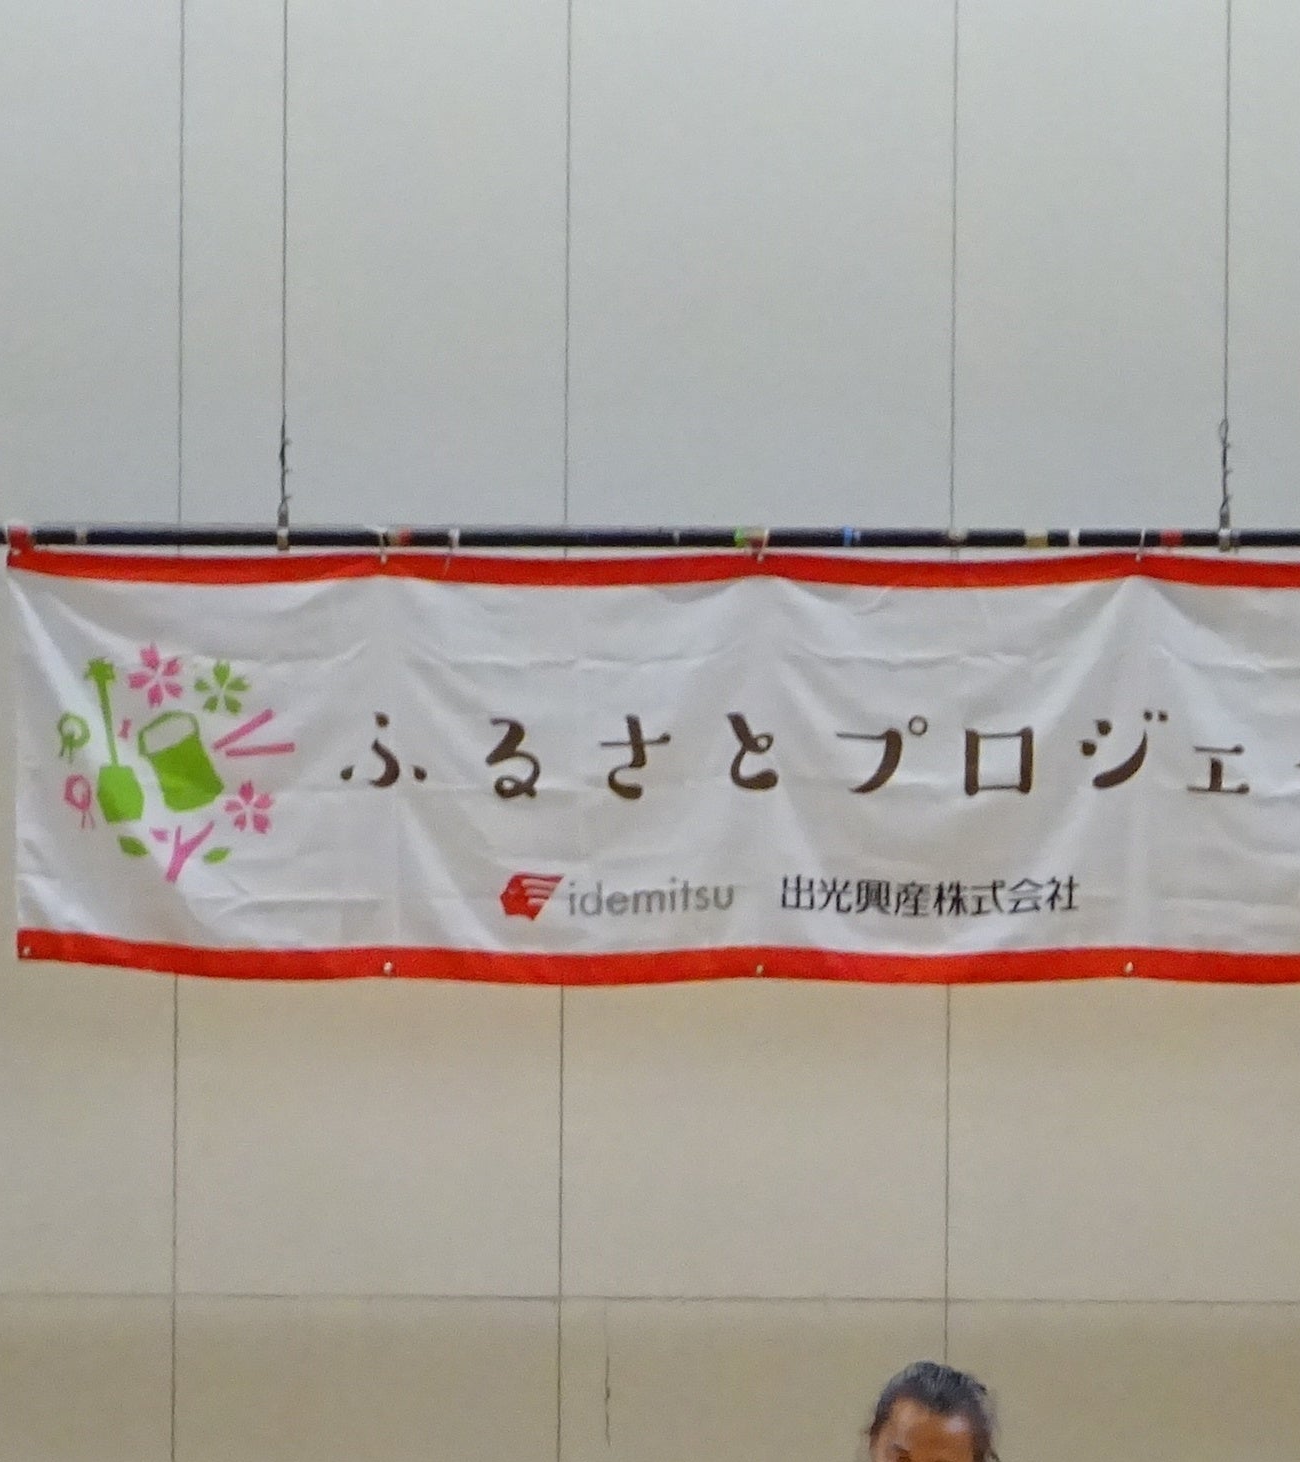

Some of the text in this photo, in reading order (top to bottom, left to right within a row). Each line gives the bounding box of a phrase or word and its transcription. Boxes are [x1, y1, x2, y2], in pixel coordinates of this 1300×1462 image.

[567, 876, 735, 917] idemitsu
[780, 873, 1080, 917] 出光興産株式会社
